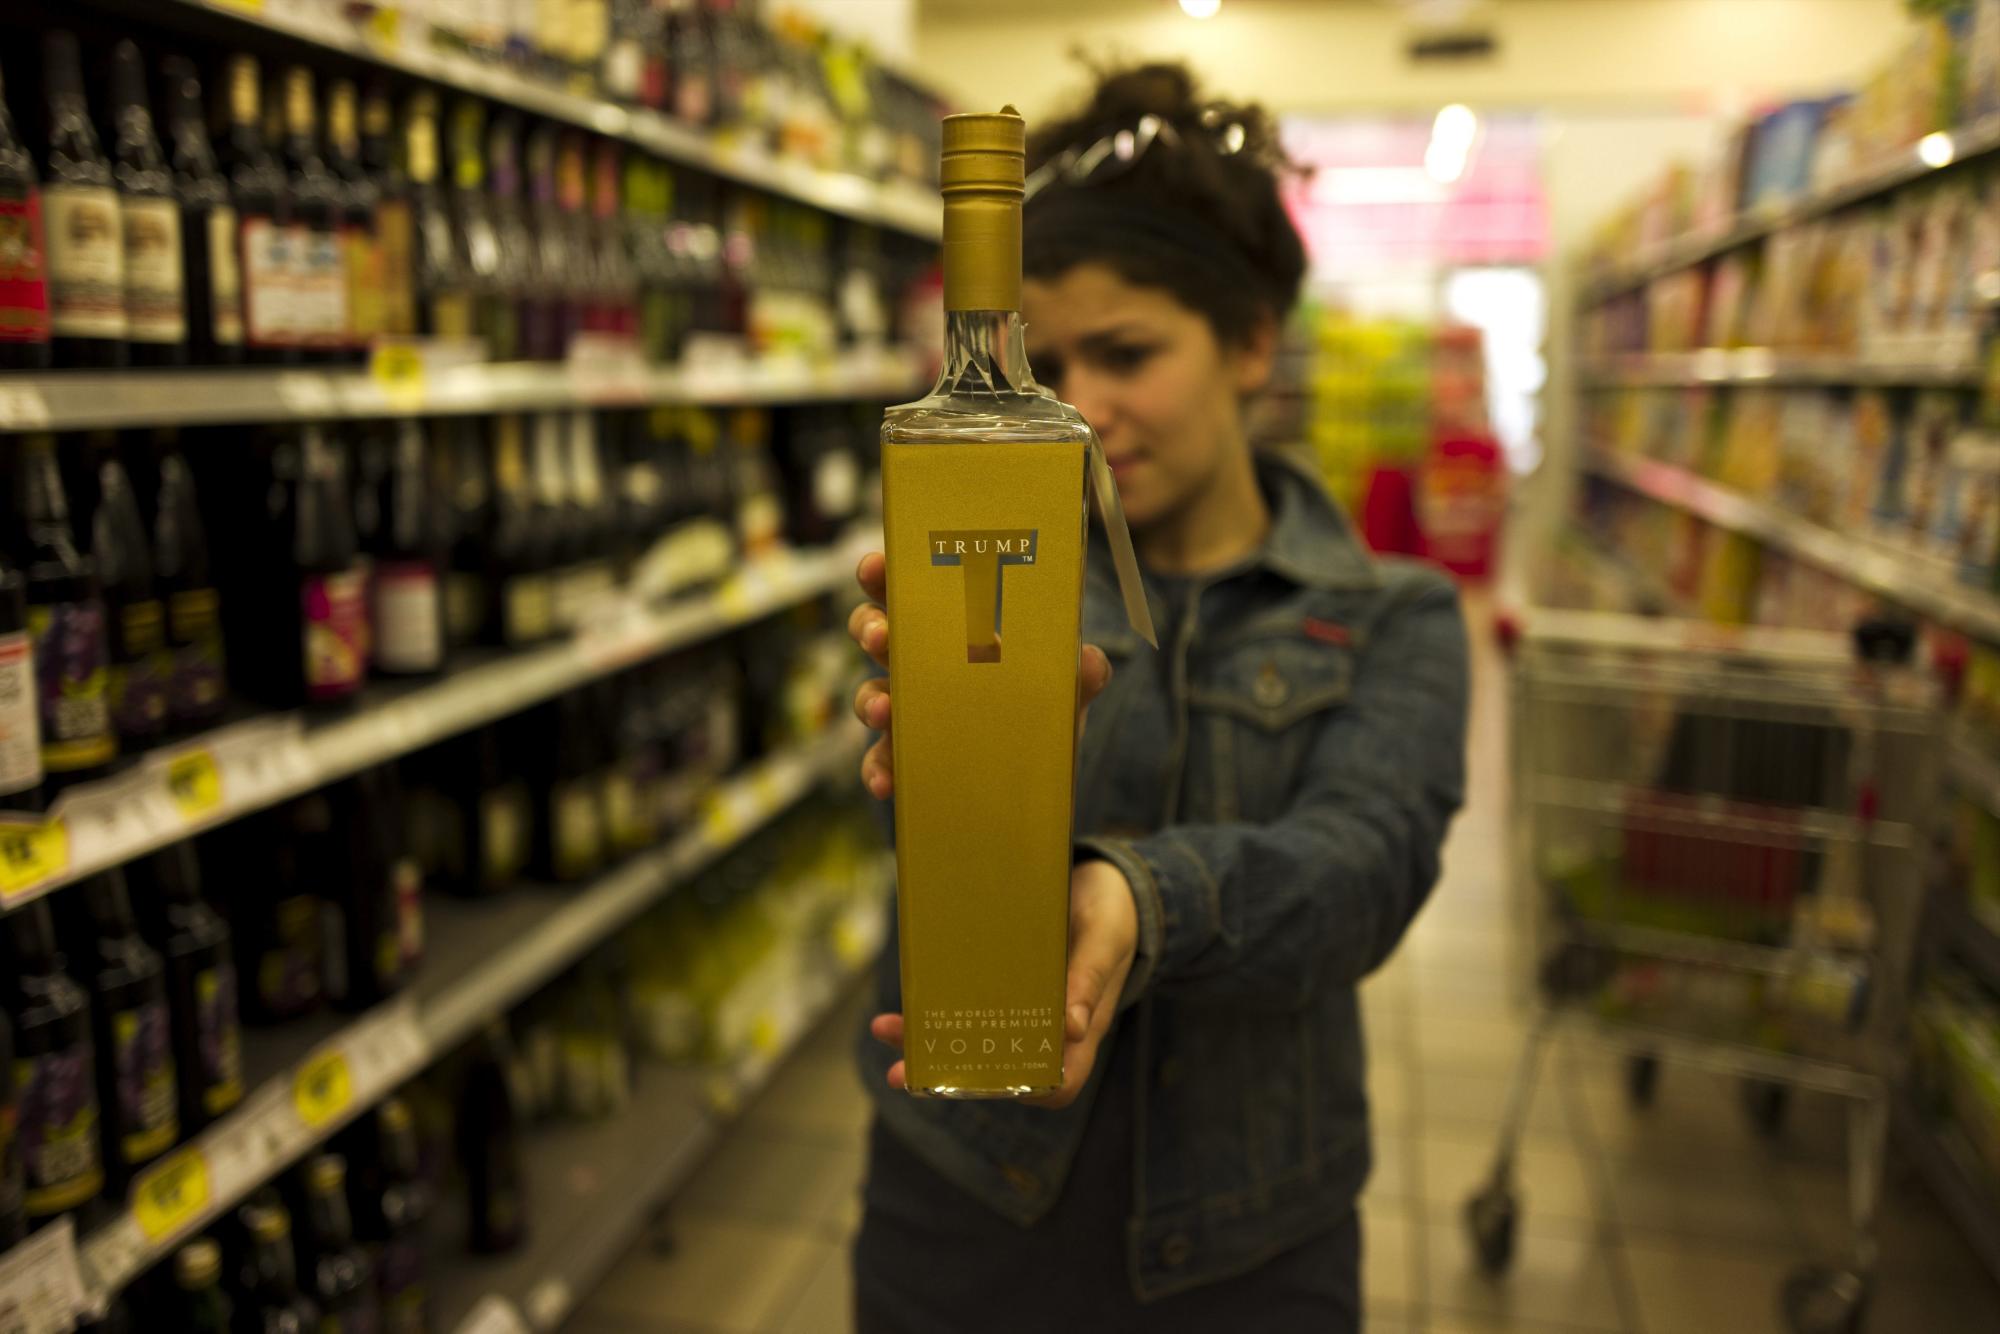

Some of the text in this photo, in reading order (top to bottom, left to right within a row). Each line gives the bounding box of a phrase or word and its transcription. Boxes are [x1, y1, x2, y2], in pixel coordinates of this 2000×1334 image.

[935, 539, 1030, 554] TRUMP
[1022, 555, 1033, 563] TM
[924, 1007, 1052, 1018] THE WORLD'S FINEST
[924, 1018, 1052, 1030] SUPER PREMIUM
[924, 1038, 1053, 1054] VODKA
